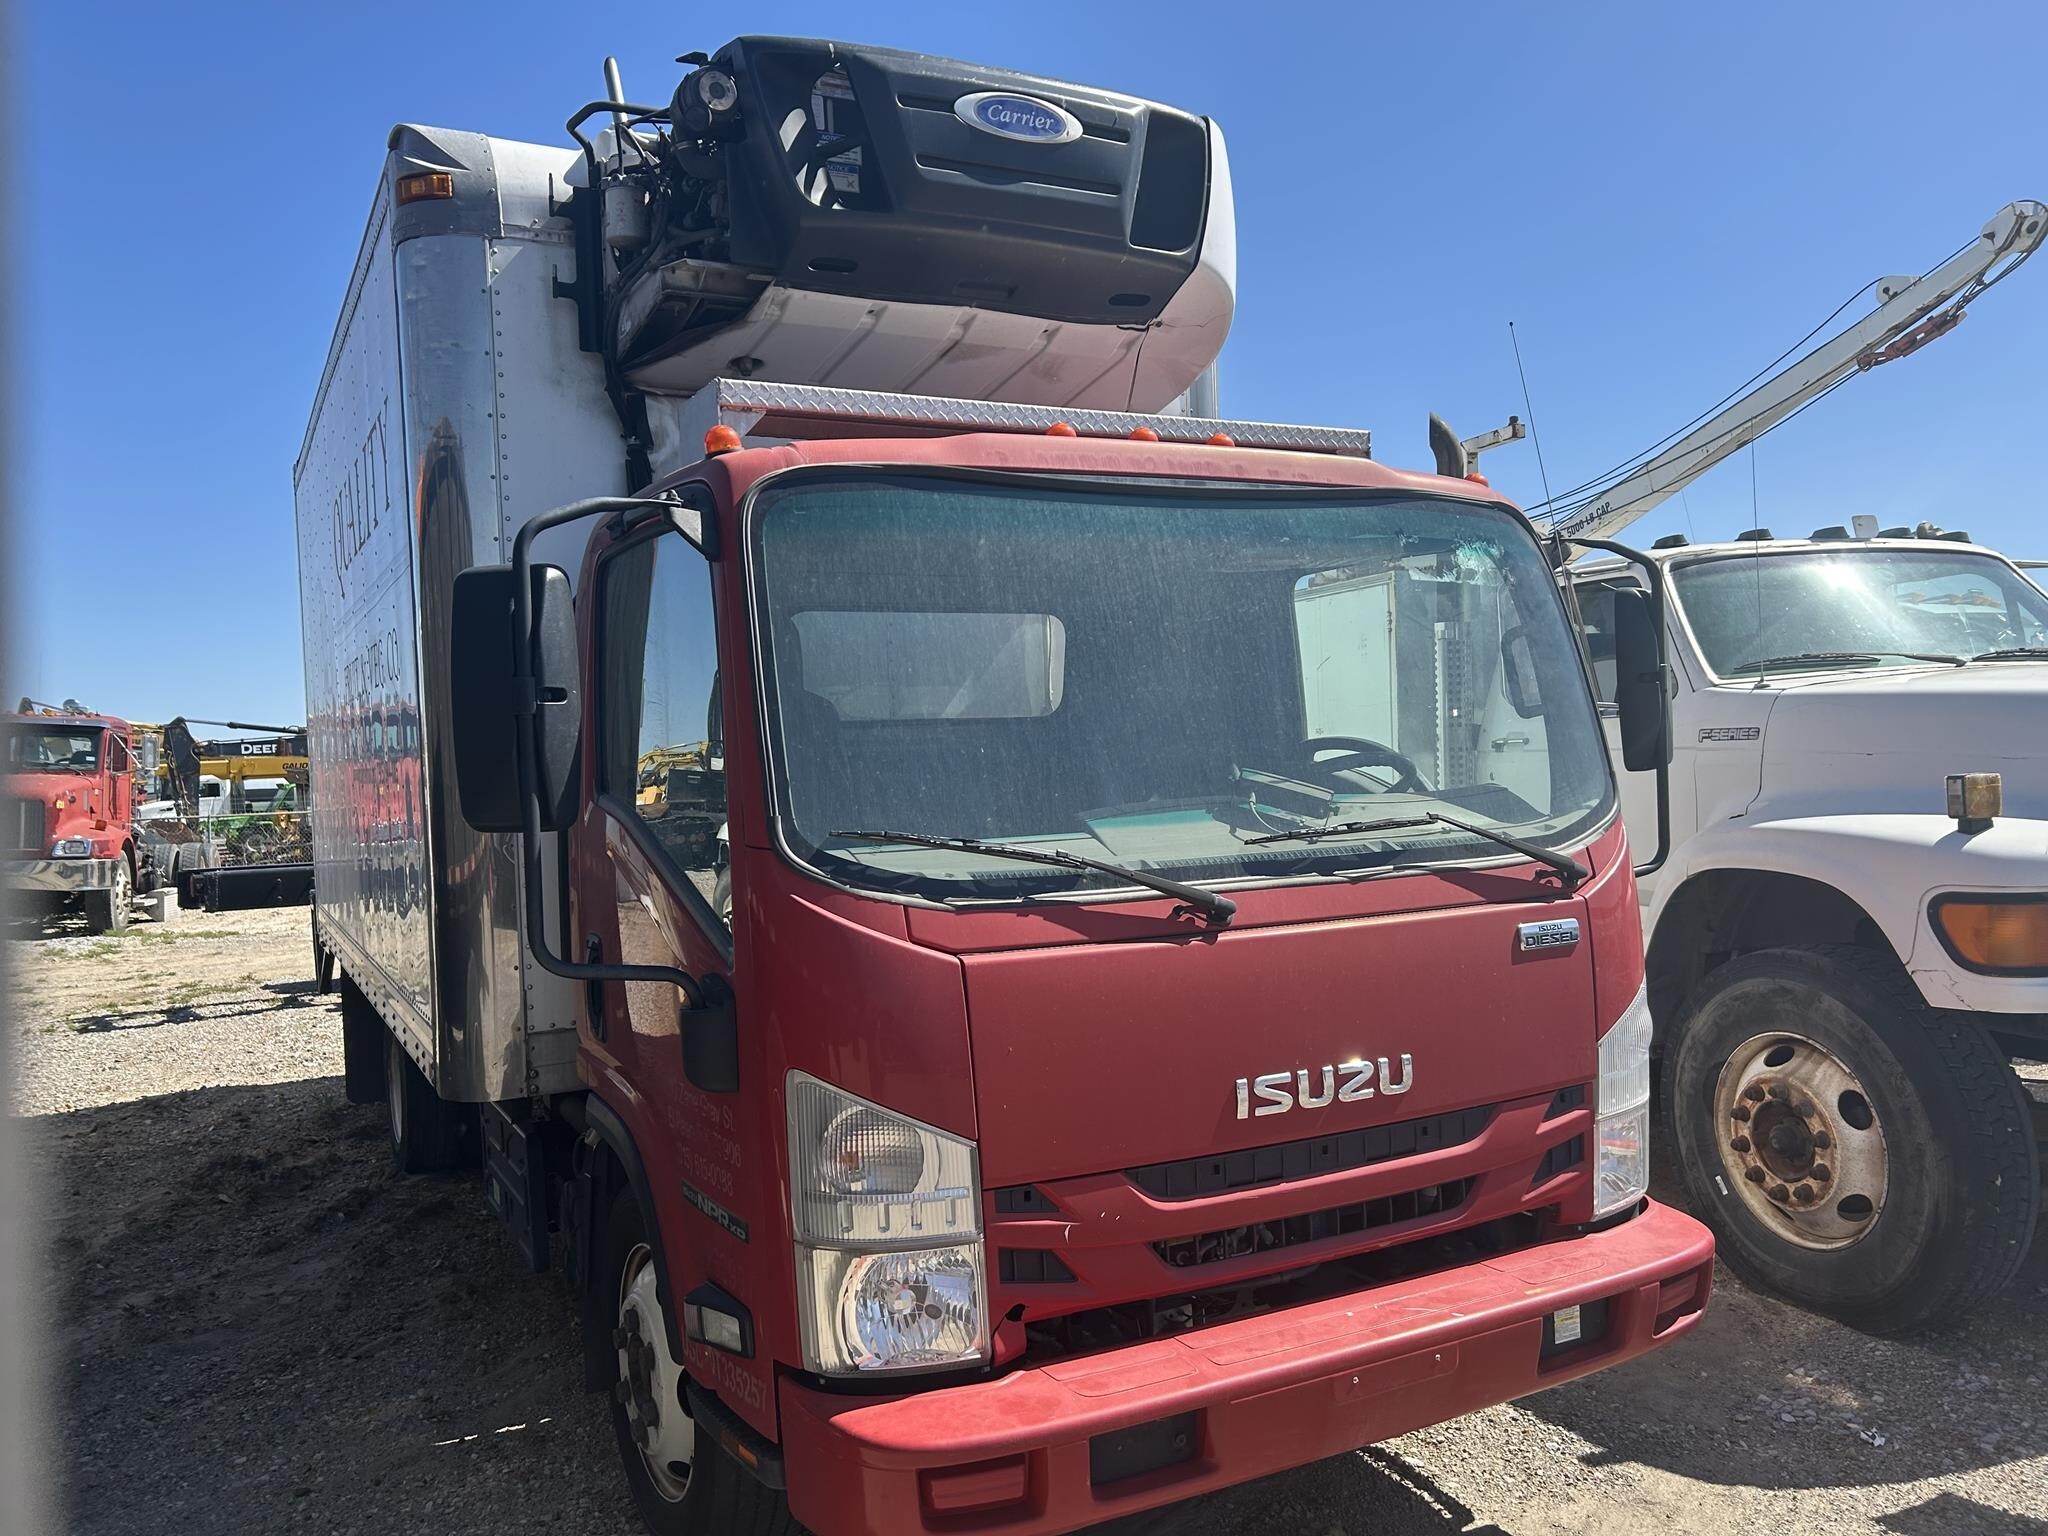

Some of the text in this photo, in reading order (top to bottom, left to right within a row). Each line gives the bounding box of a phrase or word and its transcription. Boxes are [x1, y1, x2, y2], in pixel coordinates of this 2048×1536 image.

[987, 104, 1055, 130] Carrier
[333, 395, 391, 600] QUALITY
[1566, 519, 1585, 538] 5000
[1585, 511, 1595, 525] LB
[1525, 931, 1579, 947] DIESEL
[1538, 923, 1563, 932] ISUZU
[1236, 1053, 1413, 1120] ISUZU
